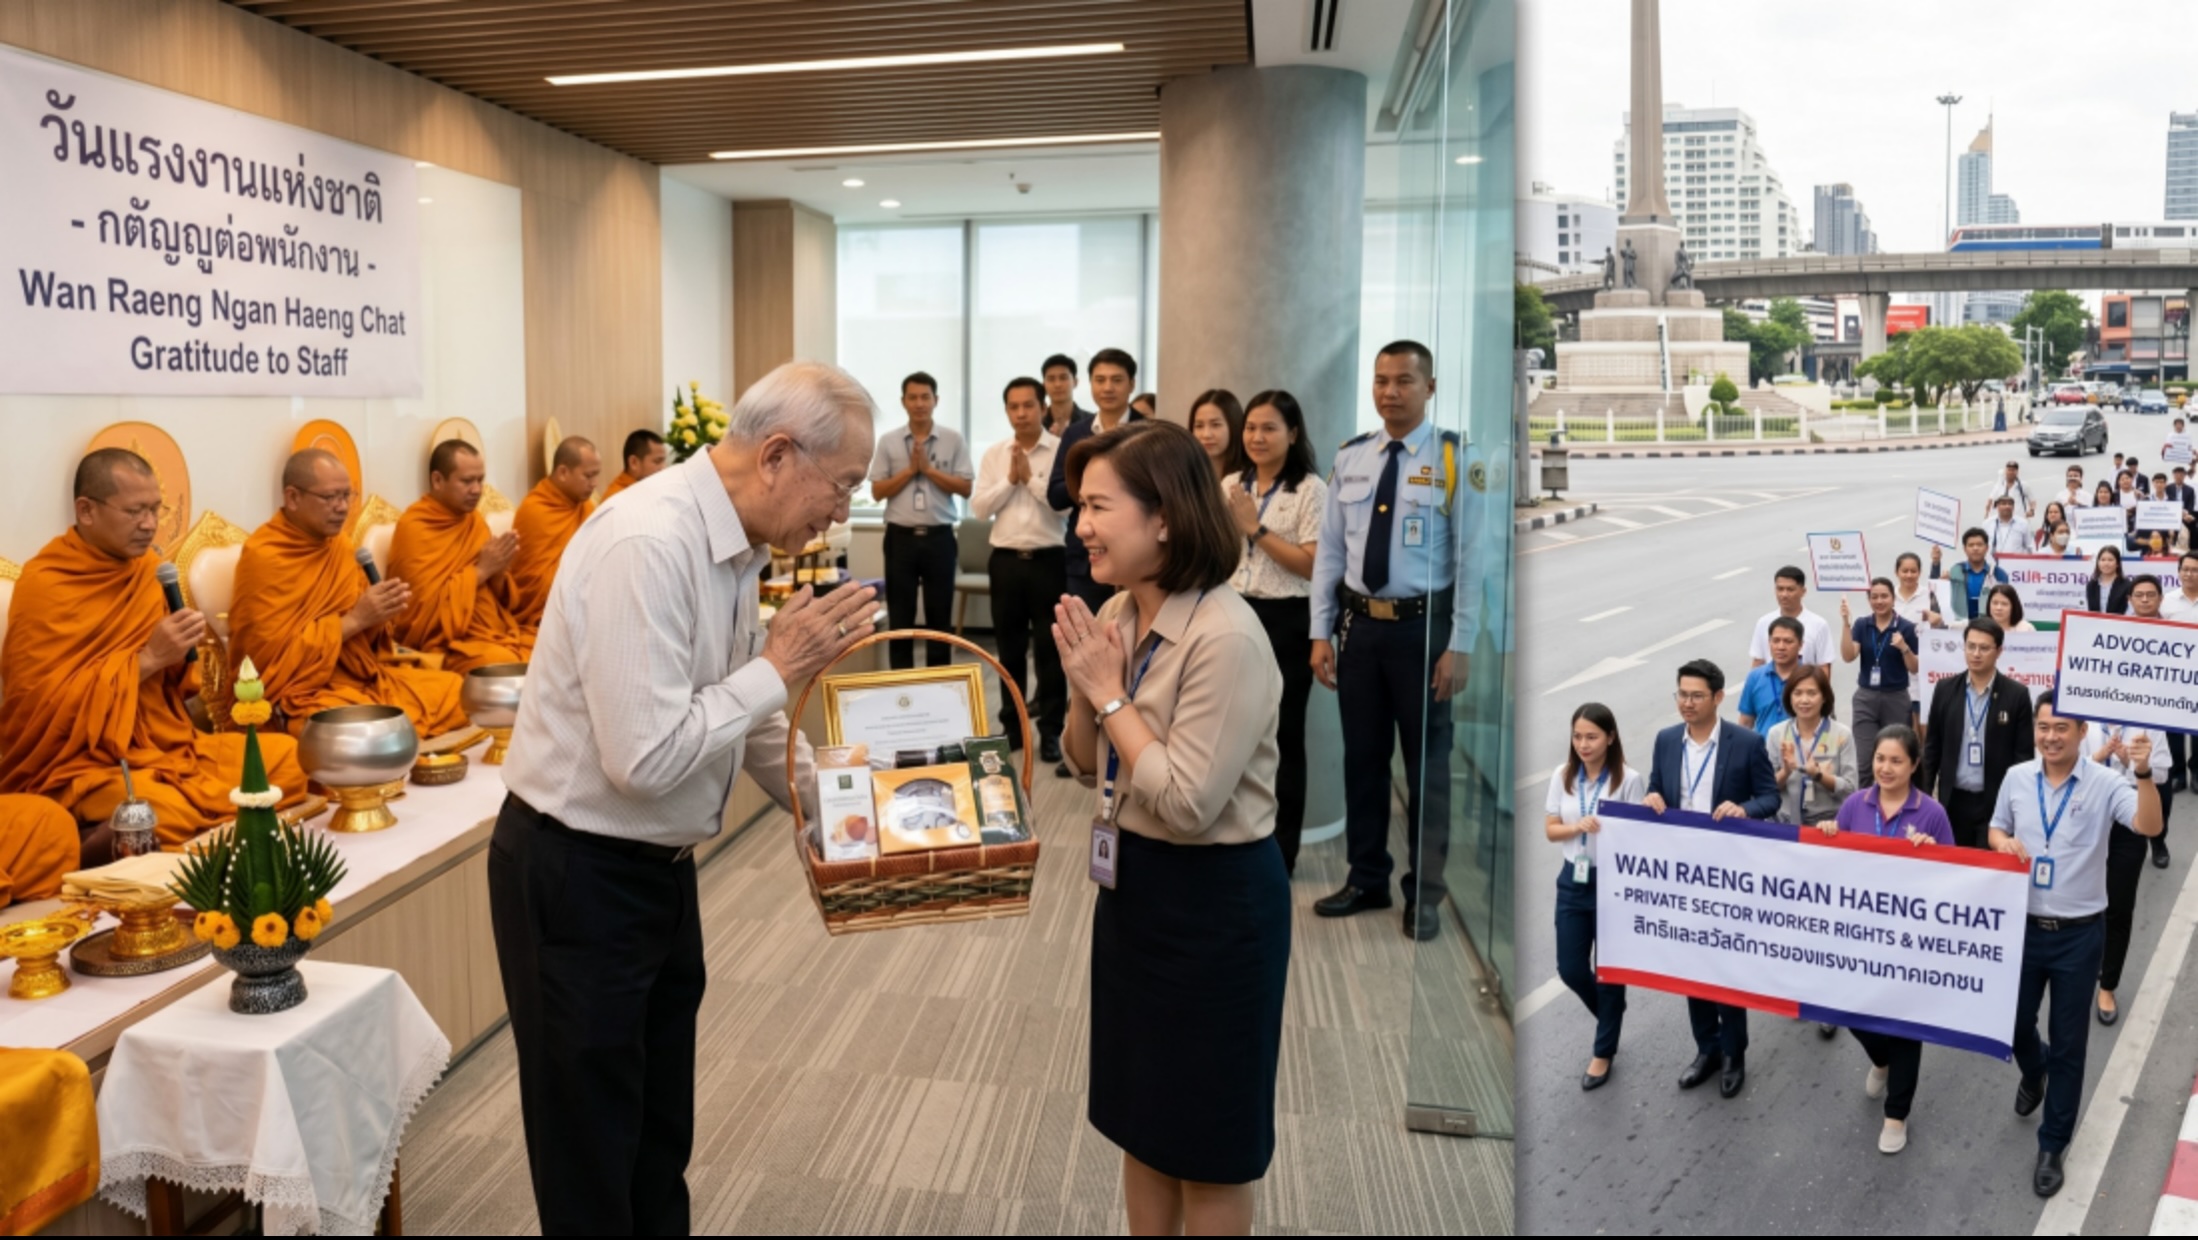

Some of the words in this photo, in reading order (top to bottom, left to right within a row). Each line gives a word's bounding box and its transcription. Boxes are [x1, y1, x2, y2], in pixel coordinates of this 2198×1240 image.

[40, 88, 383, 224] วันแรงงานแห่งชาติ
[98, 197, 361, 277] กตัญญูต่อพนักงาน
[19, 268, 96, 311] Wan
[108, 277, 201, 327] Raeng
[212, 290, 276, 330] Ngan
[285, 298, 353, 337] Haeng
[361, 306, 405, 335] Chat
[131, 336, 259, 373] Gratitude
[267, 346, 289, 375] to
[297, 346, 348, 376] Staff
[2068, 656, 2112, 675] WITH
[2092, 633, 2195, 658] ADVOCACY
[1615, 853, 1668, 880] WAN
[1676, 862, 1753, 894] RAENG
[1762, 876, 1831, 905] NGAN
[1840, 887, 1927, 921] HAENG
[1934, 902, 2006, 931] CHAT
[1624, 887, 1688, 911] PRIVATE
[1692, 898, 1753, 922] SECTOR
[1757, 909, 1829, 935] WORKER
[1834, 922, 1895, 946] RIGHTS
[1900, 932, 1914, 949] &
[1918, 936, 2003, 963] WELFARE
[1634, 915, 1984, 993] สิทธิและสวัสดิการของแรงงานภาคเอกชน
